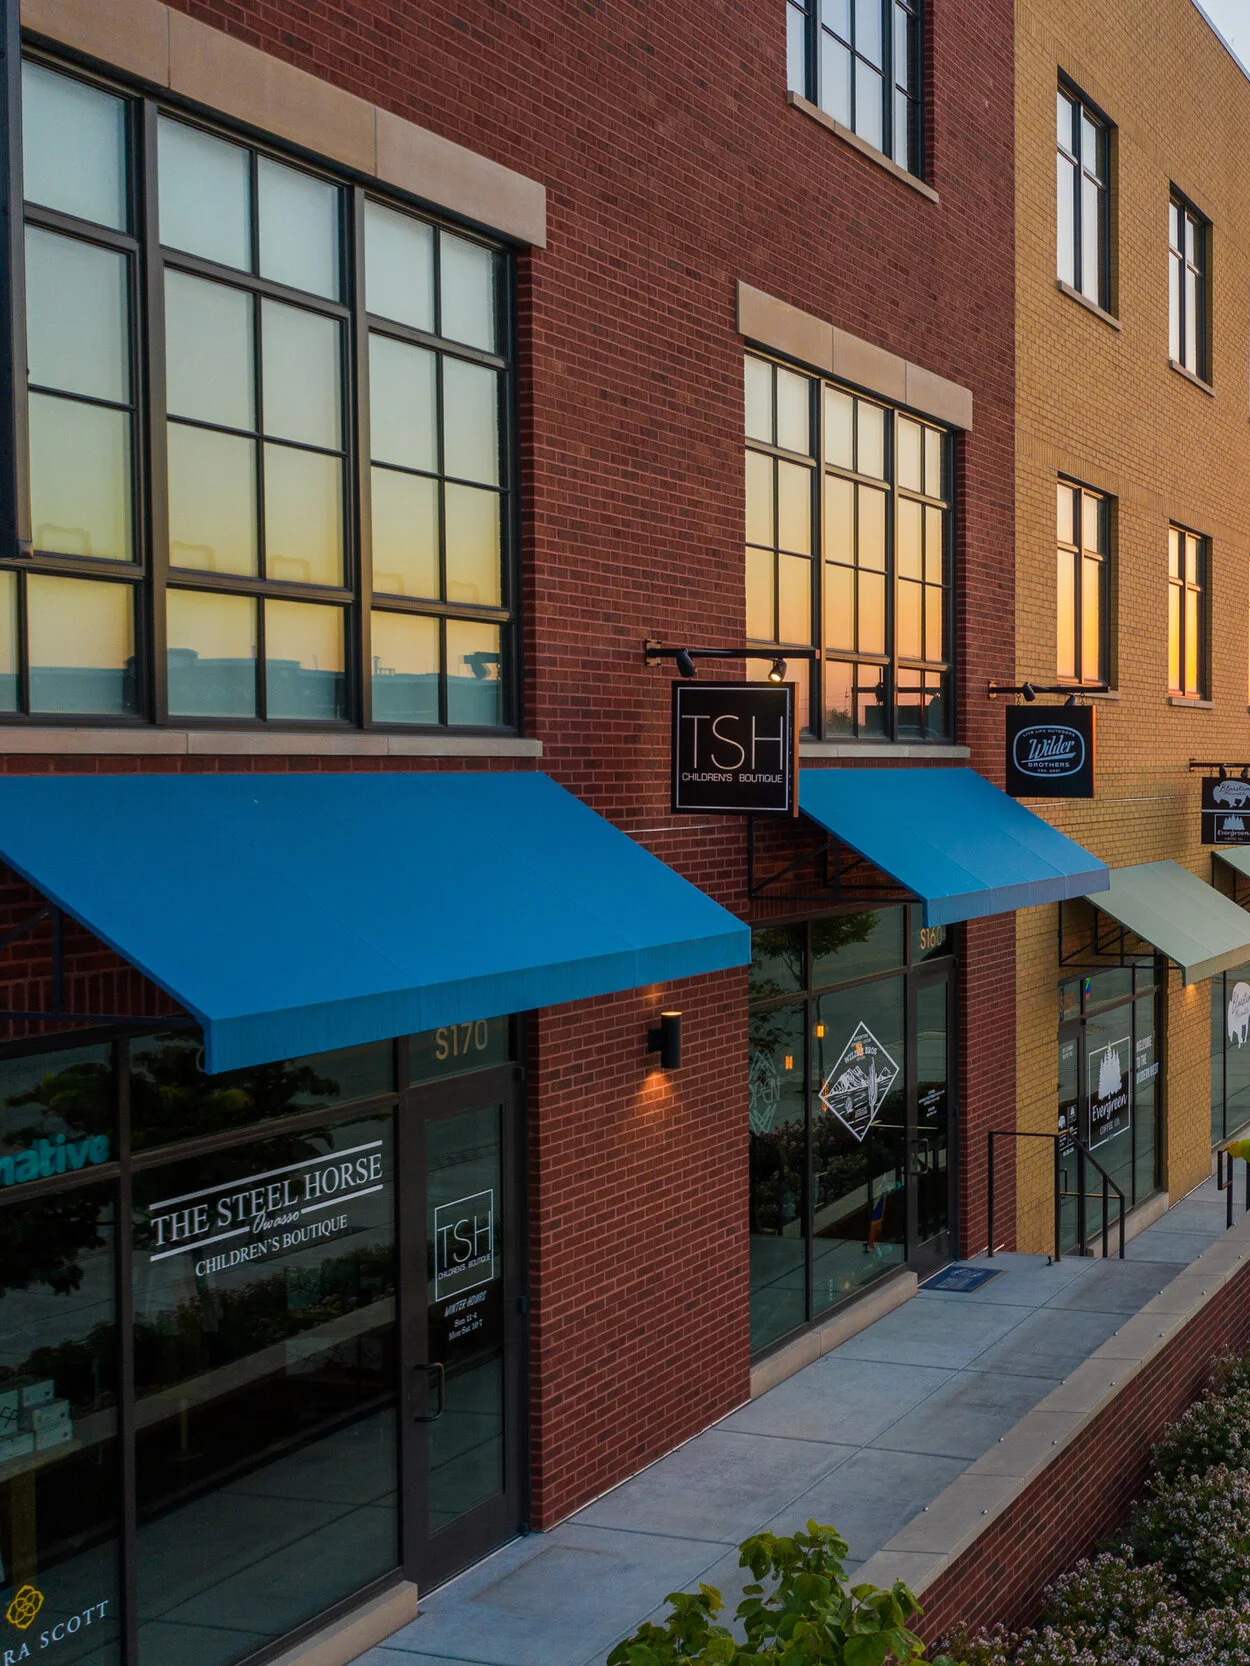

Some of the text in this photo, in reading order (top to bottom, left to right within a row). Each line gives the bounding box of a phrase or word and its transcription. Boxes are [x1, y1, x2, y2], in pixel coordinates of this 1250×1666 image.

[682, 715, 783, 770] TSH
[1029, 735, 1076, 760] Wilder
[682, 773, 783, 783] CHILDREN'S BOUTIQUE
[435, 1019, 489, 1061] S170
[865, 1046, 878, 1056] BROS
[1092, 1093, 1128, 1122] Evergreen
[150, 1153, 383, 1247] THE STEEL HORSE
[252, 1208, 301, 1235] Owasso
[283, 1214, 349, 1252] BOUTIQUE
[437, 1210, 491, 1268] TSH
[467, 1253, 491, 1269] BOUTIQUE
[444, 1289, 487, 1318] WINTER HOURS
[40, 1600, 109, 1649] SCOTT
